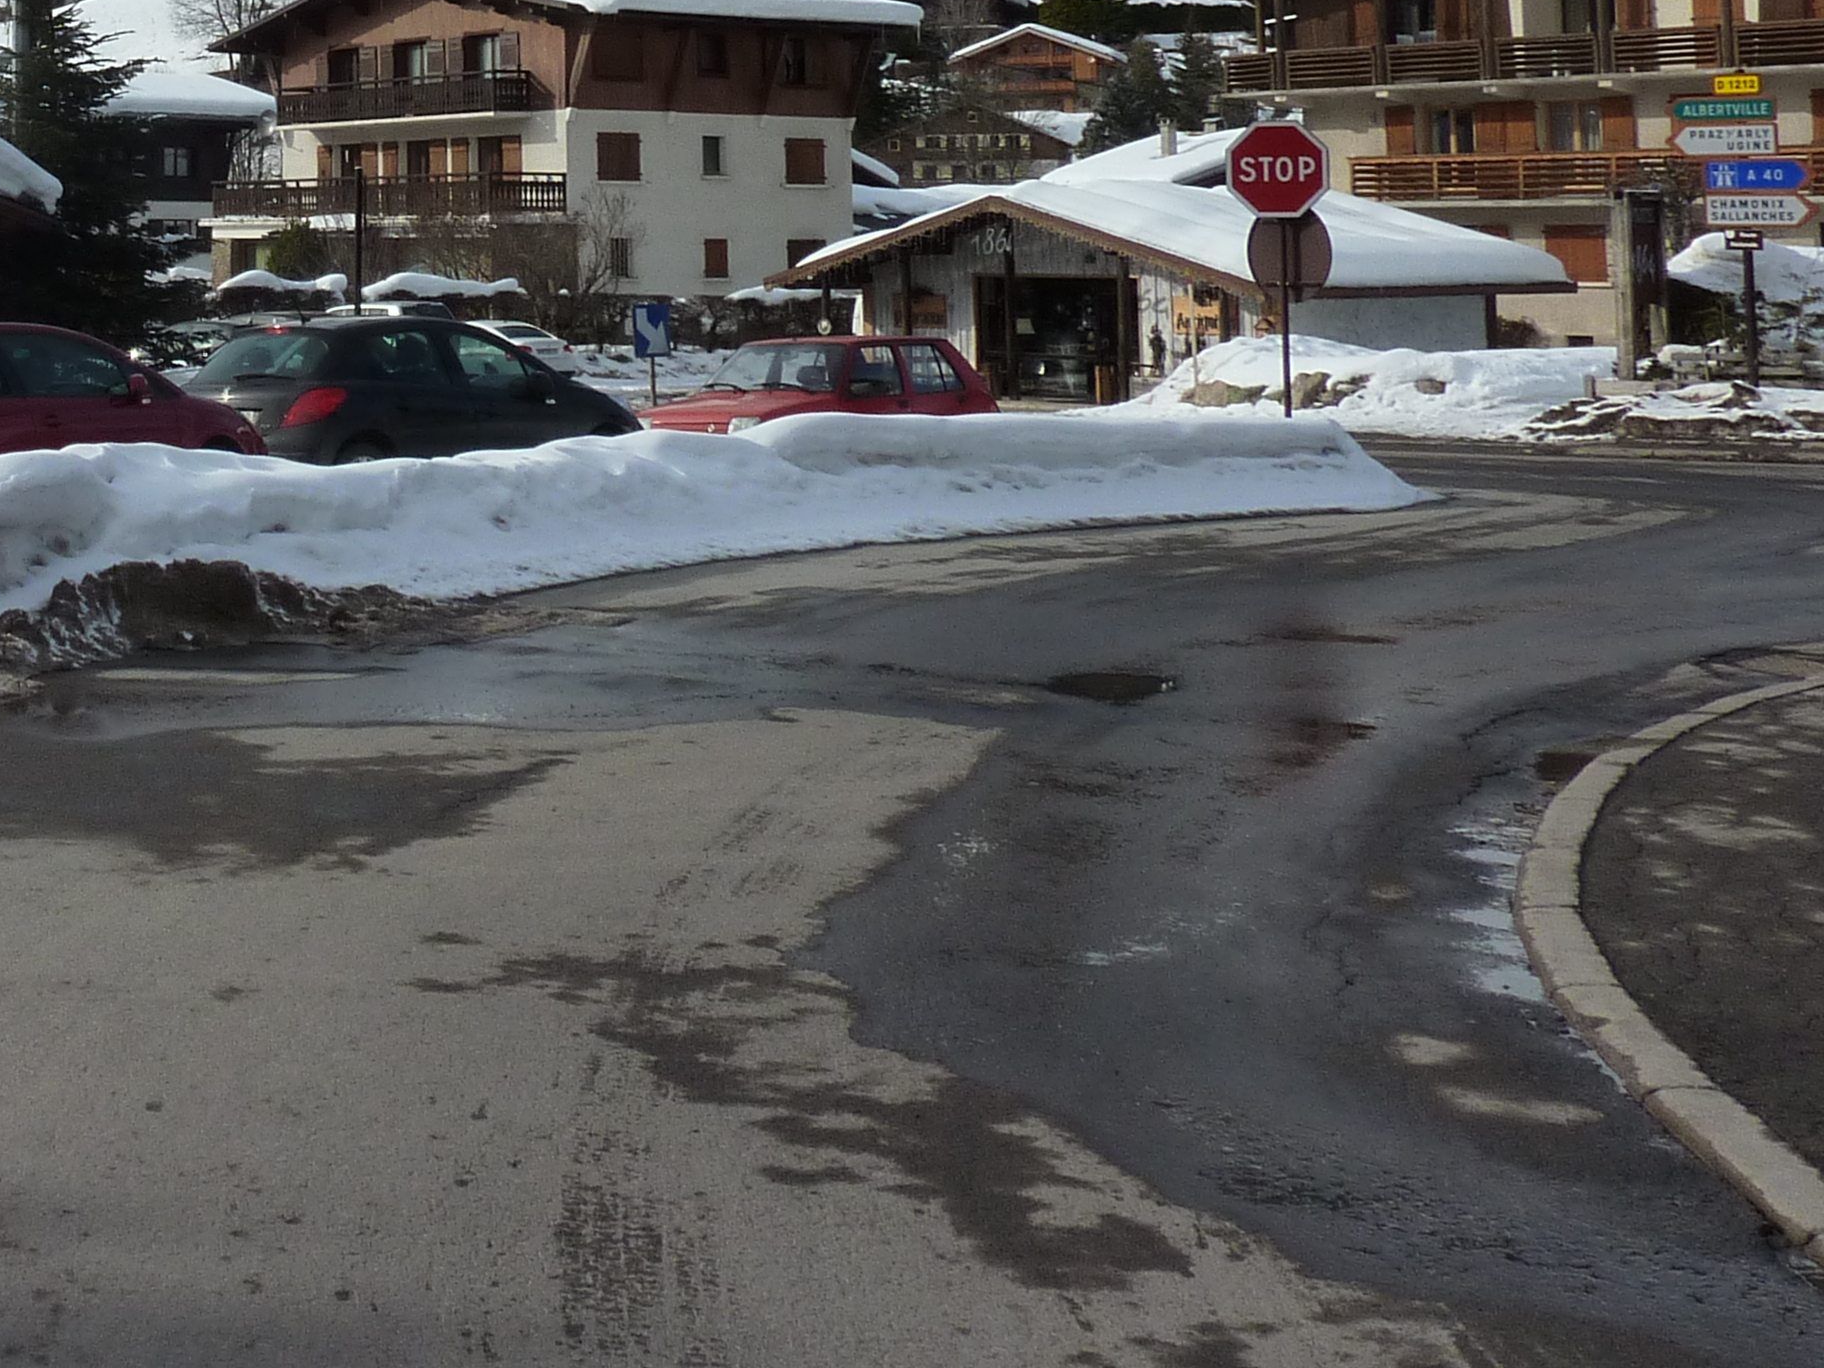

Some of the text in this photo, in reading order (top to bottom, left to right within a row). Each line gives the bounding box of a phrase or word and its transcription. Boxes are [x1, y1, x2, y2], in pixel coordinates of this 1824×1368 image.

[1717, 79, 1756, 90] D 1212
[1682, 103, 1770, 117] ALBERTVILLE
[1689, 130, 1723, 140] PRAZ
[1736, 128, 1770, 139] ARLY
[1727, 141, 1771, 151] UGINE
[1239, 156, 1316, 183] STOP
[1747, 168, 1783, 181] A 40
[1710, 199, 1785, 209] CHAMONIX
[1710, 212, 1795, 221] SALLANCHES
